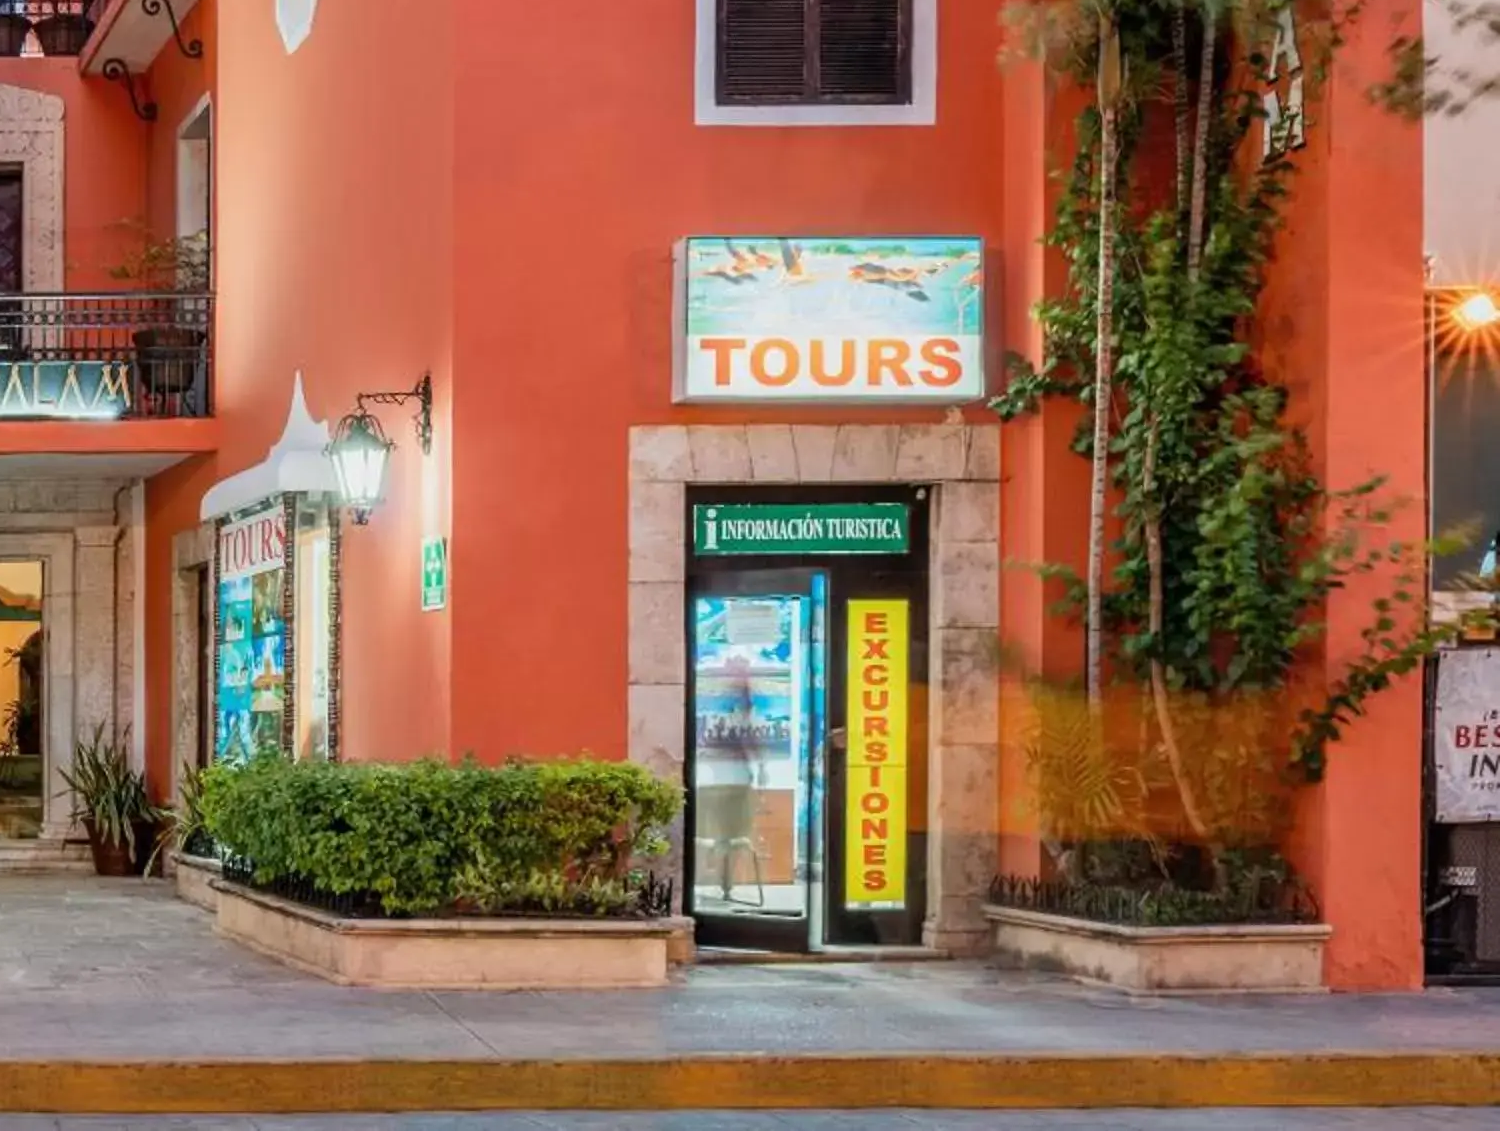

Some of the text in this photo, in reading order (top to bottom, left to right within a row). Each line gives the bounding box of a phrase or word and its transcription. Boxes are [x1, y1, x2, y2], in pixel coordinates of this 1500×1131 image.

[700, 338, 962, 387] TOURS
[220, 512, 286, 573] TOURS
[721, 513, 824, 541] INFORMACIÓN
[861, 612, 890, 892] EXCURSIONES
